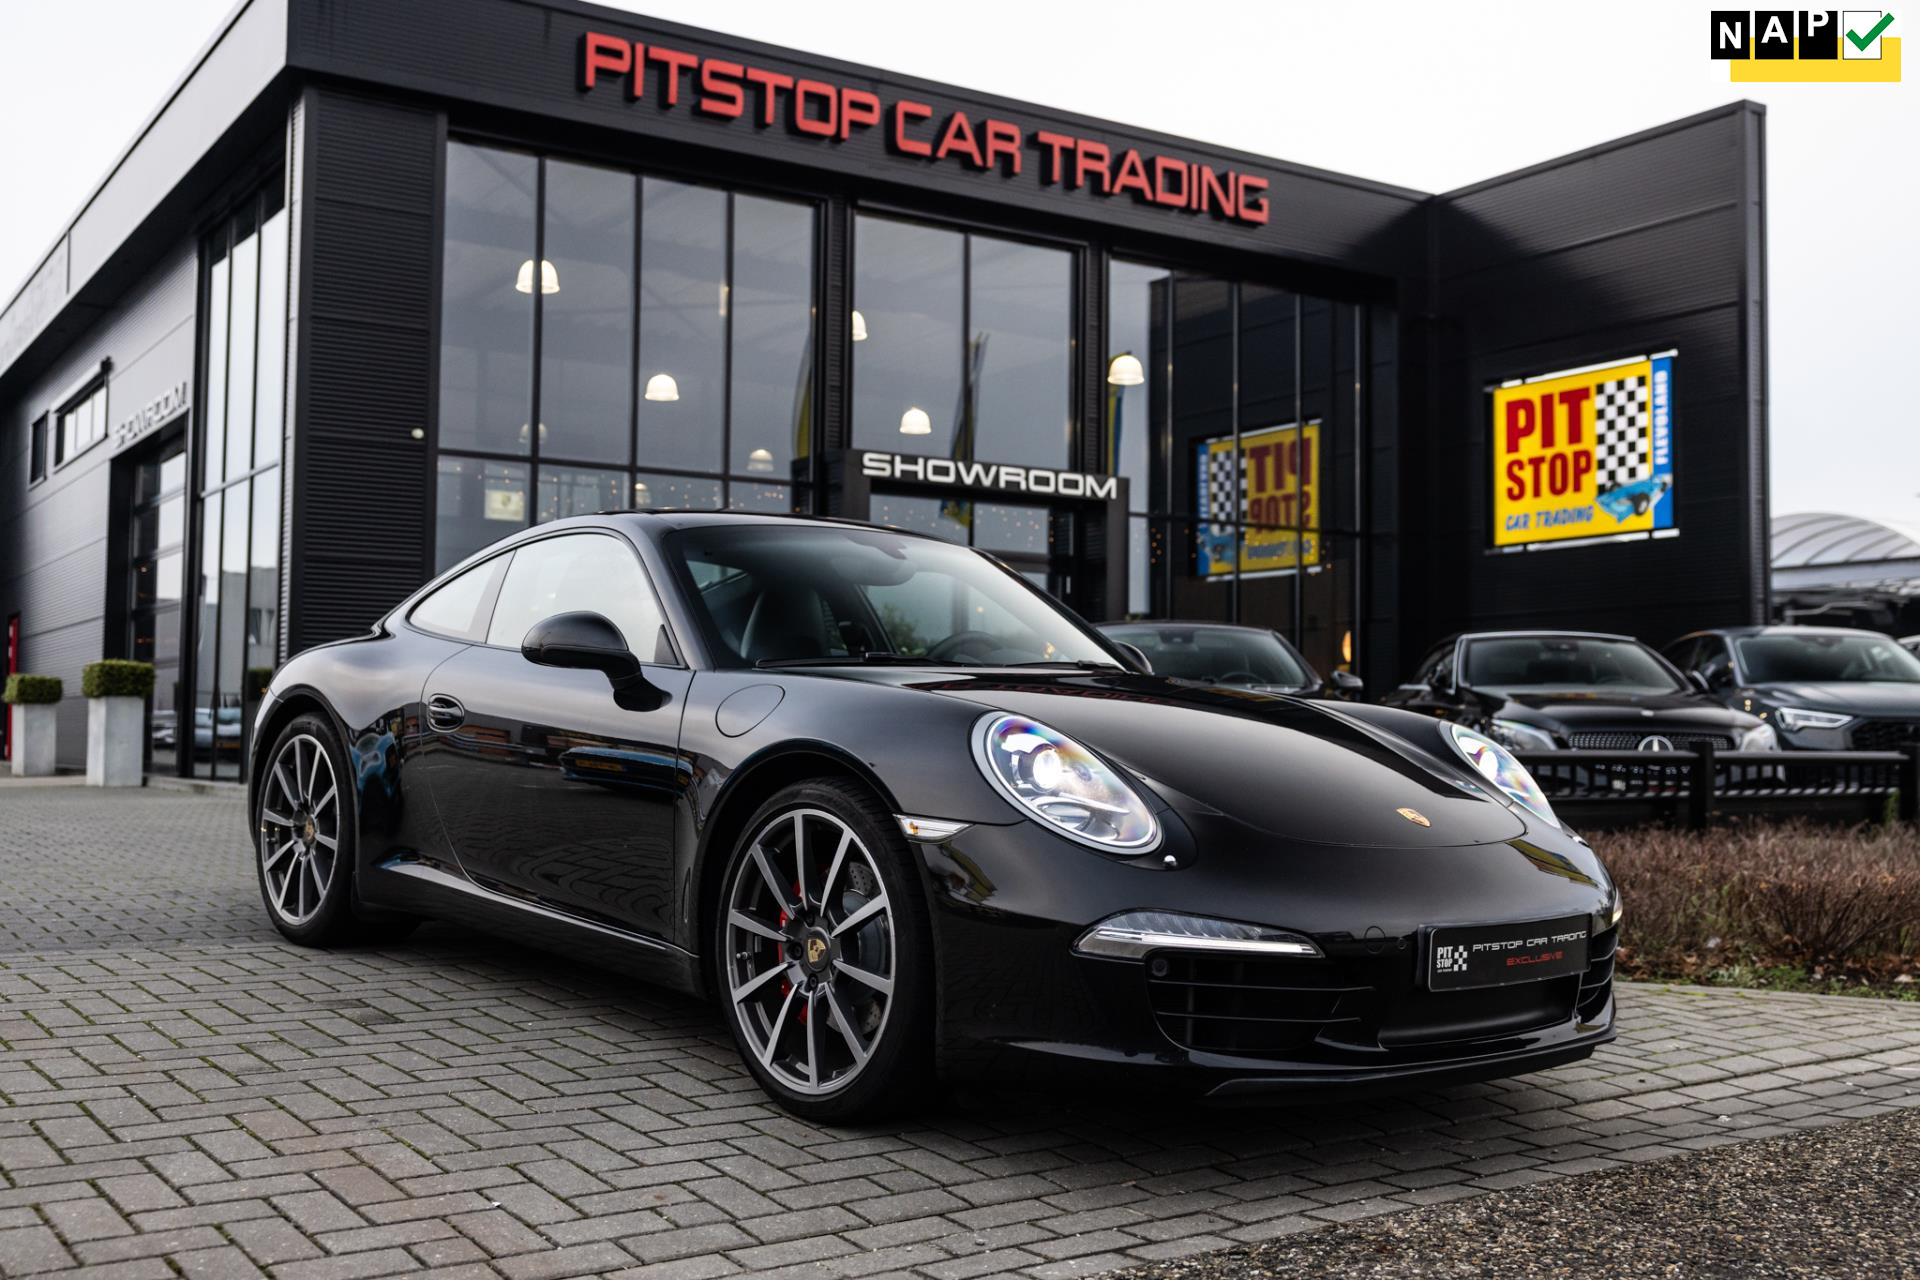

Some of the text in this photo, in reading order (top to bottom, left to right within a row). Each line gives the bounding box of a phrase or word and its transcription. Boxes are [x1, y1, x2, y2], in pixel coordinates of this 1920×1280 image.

[585, 31, 1270, 225] PITSTOP CAR TRADING
[1505, 386, 1591, 455] PIT
[862, 451, 1118, 500] SHOWROOM
[1506, 449, 1593, 502] STOP
[1505, 504, 1595, 532] CAR TRADING
[1437, 946, 1454, 959] PIT
[1472, 930, 1587, 952] PITSTOP CAR TRADING
[1436, 958, 1453, 969] STOP
[1506, 951, 1564, 966] EXCLUSIVE
